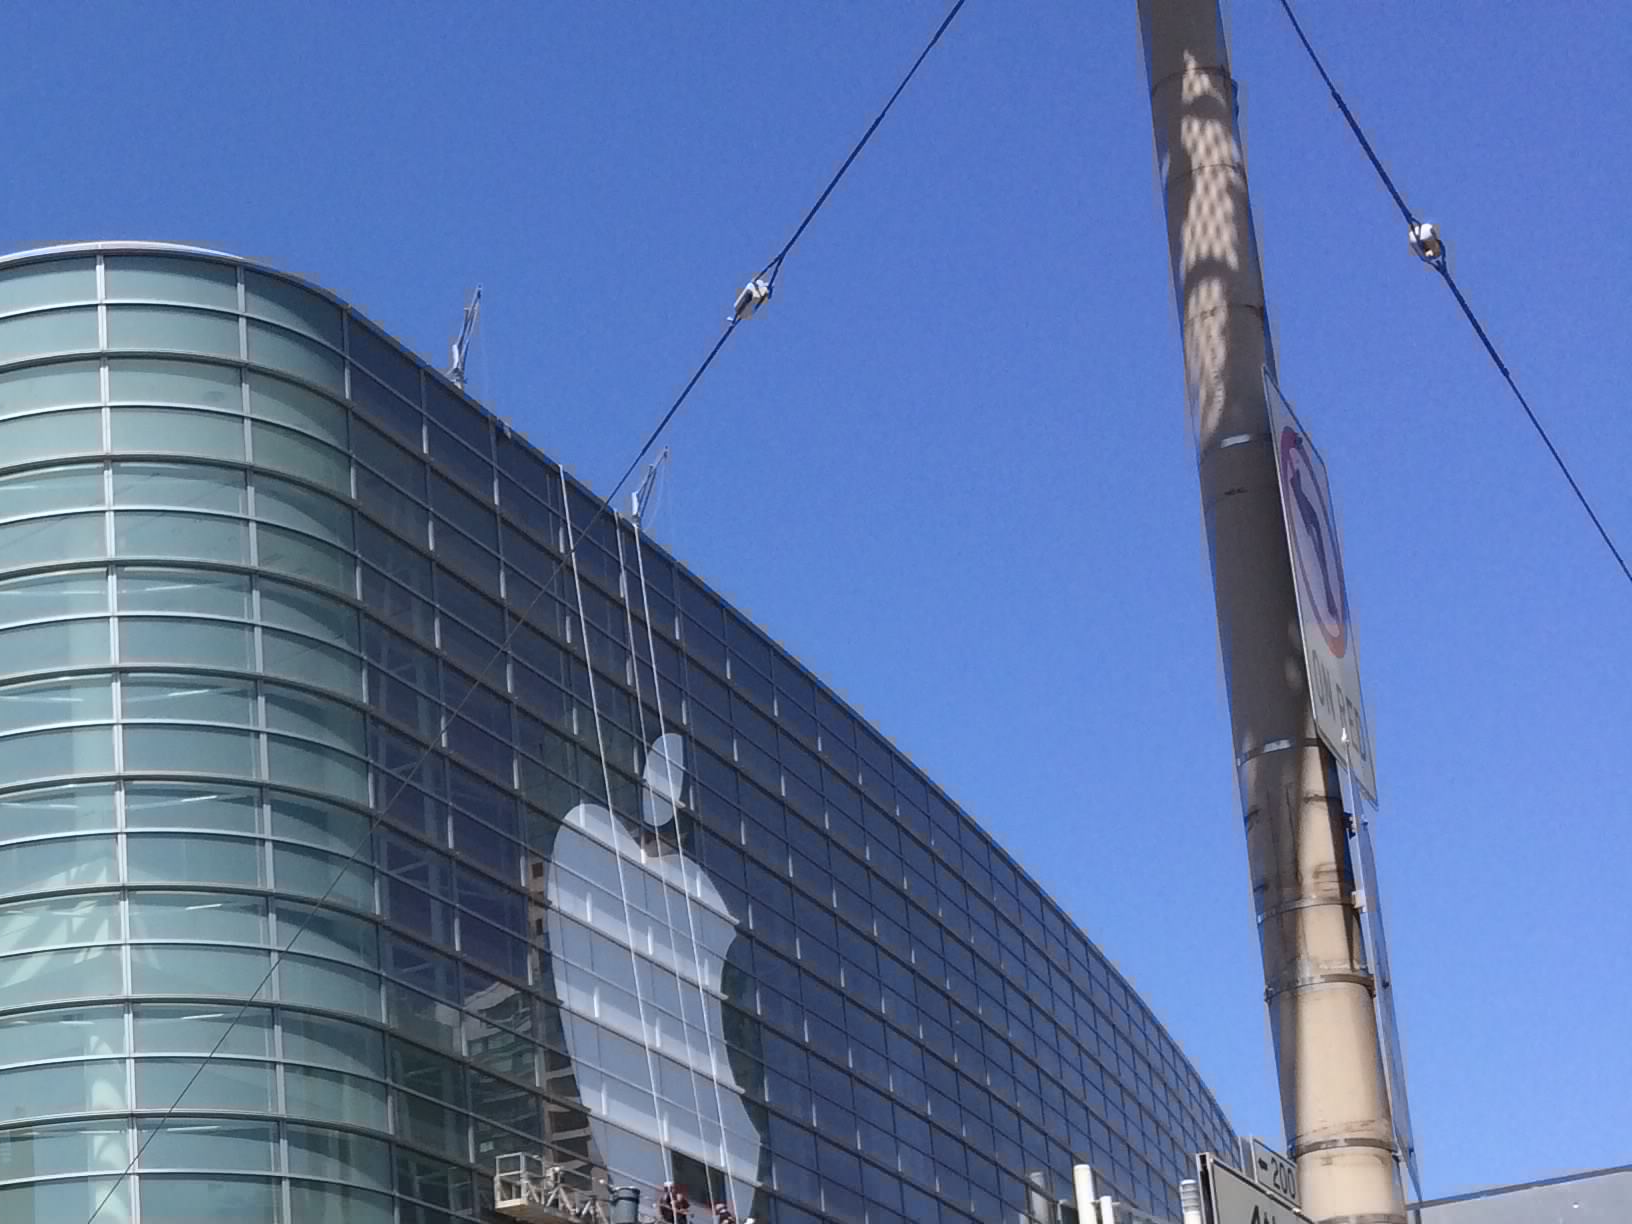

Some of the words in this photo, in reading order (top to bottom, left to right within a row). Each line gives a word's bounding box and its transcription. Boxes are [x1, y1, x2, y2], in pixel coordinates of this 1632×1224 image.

[1311, 649, 1337, 721] ON
[1335, 683, 1367, 762] RED
[1271, 1157, 1296, 1200] 200
